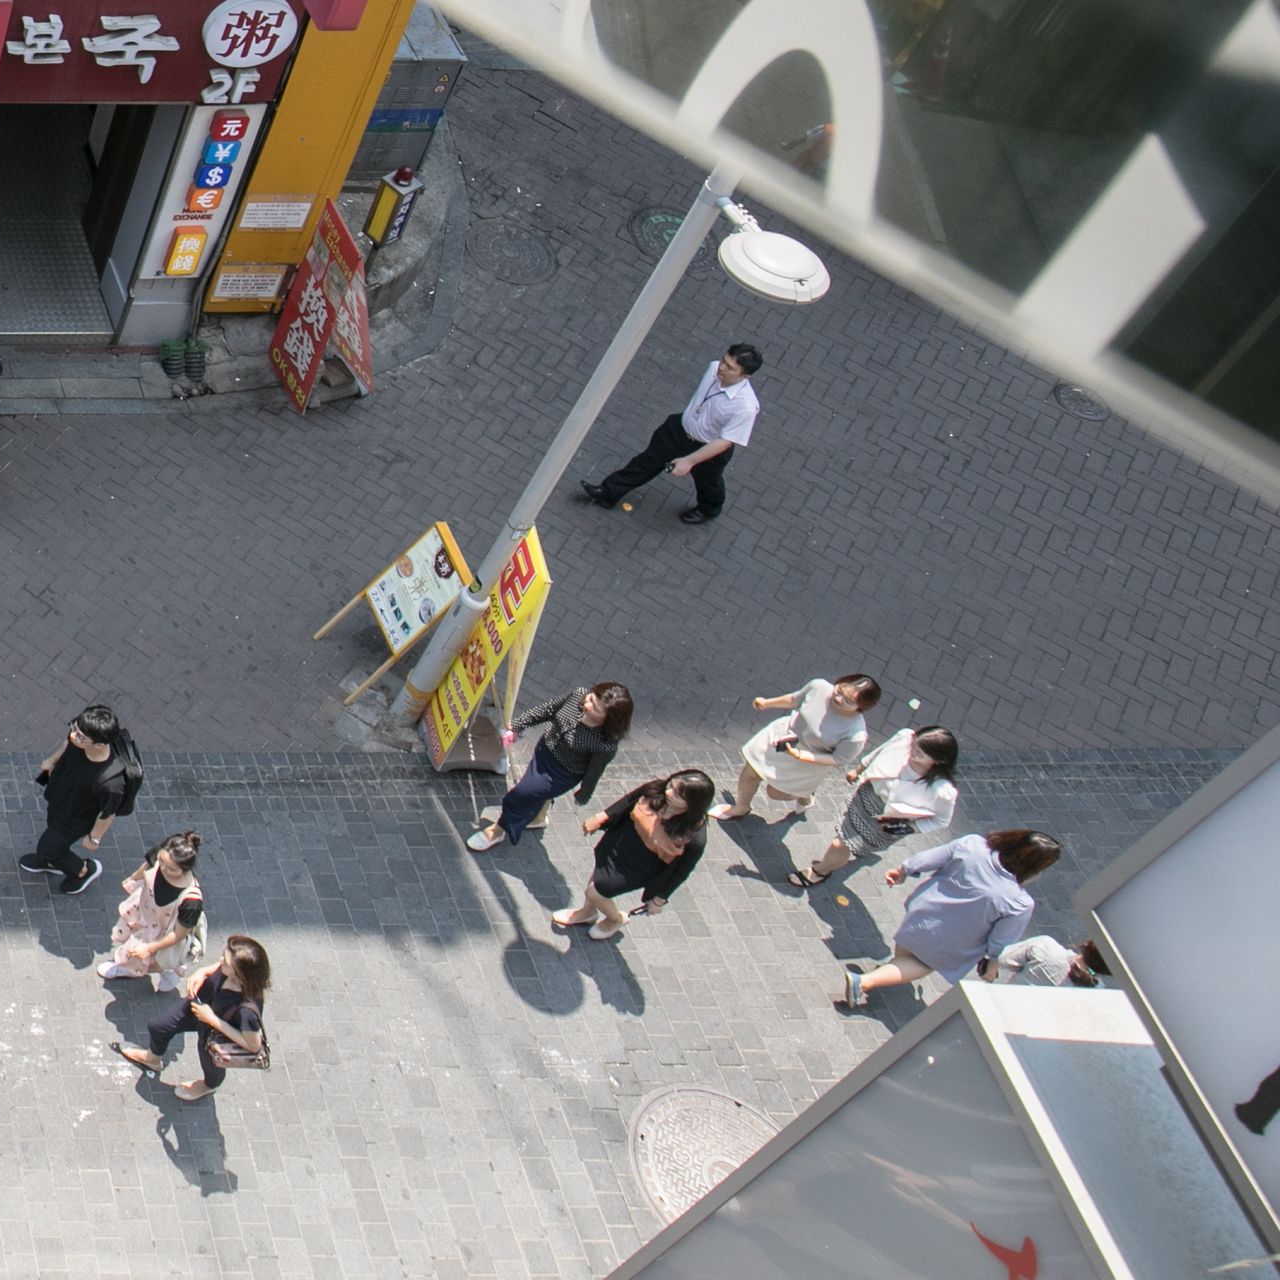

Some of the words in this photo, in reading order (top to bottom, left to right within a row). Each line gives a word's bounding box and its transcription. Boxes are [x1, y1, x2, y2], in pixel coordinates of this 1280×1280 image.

[6, 13, 180, 84] 본죽
[216, 9, 287, 59] 粥
[201, 68, 260, 104] 2F
[324, 209, 341, 243] Money
[326, 238, 353, 280] Exchange
[283, 277, 329, 381] 換錢
